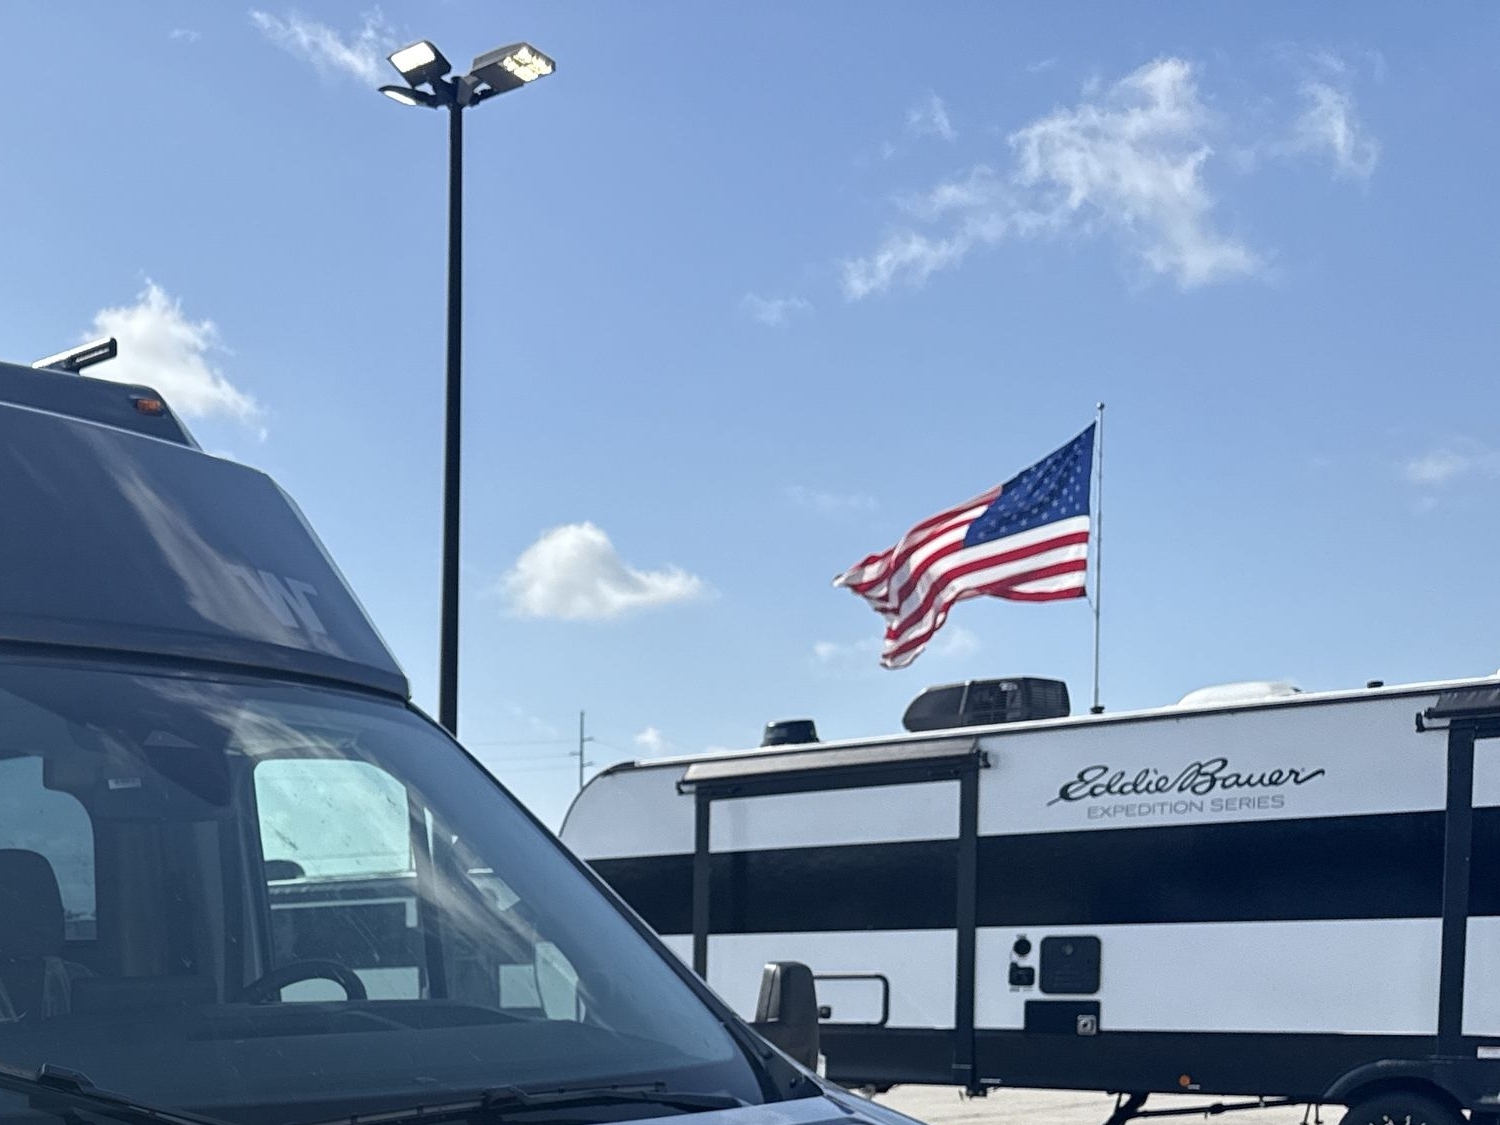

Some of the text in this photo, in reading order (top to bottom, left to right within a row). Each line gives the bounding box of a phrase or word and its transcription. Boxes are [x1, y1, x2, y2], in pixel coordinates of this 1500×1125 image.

[1046, 757, 1326, 806] Eddie Bauer
[1087, 794, 1285, 819] EXPEDITION SERIES
